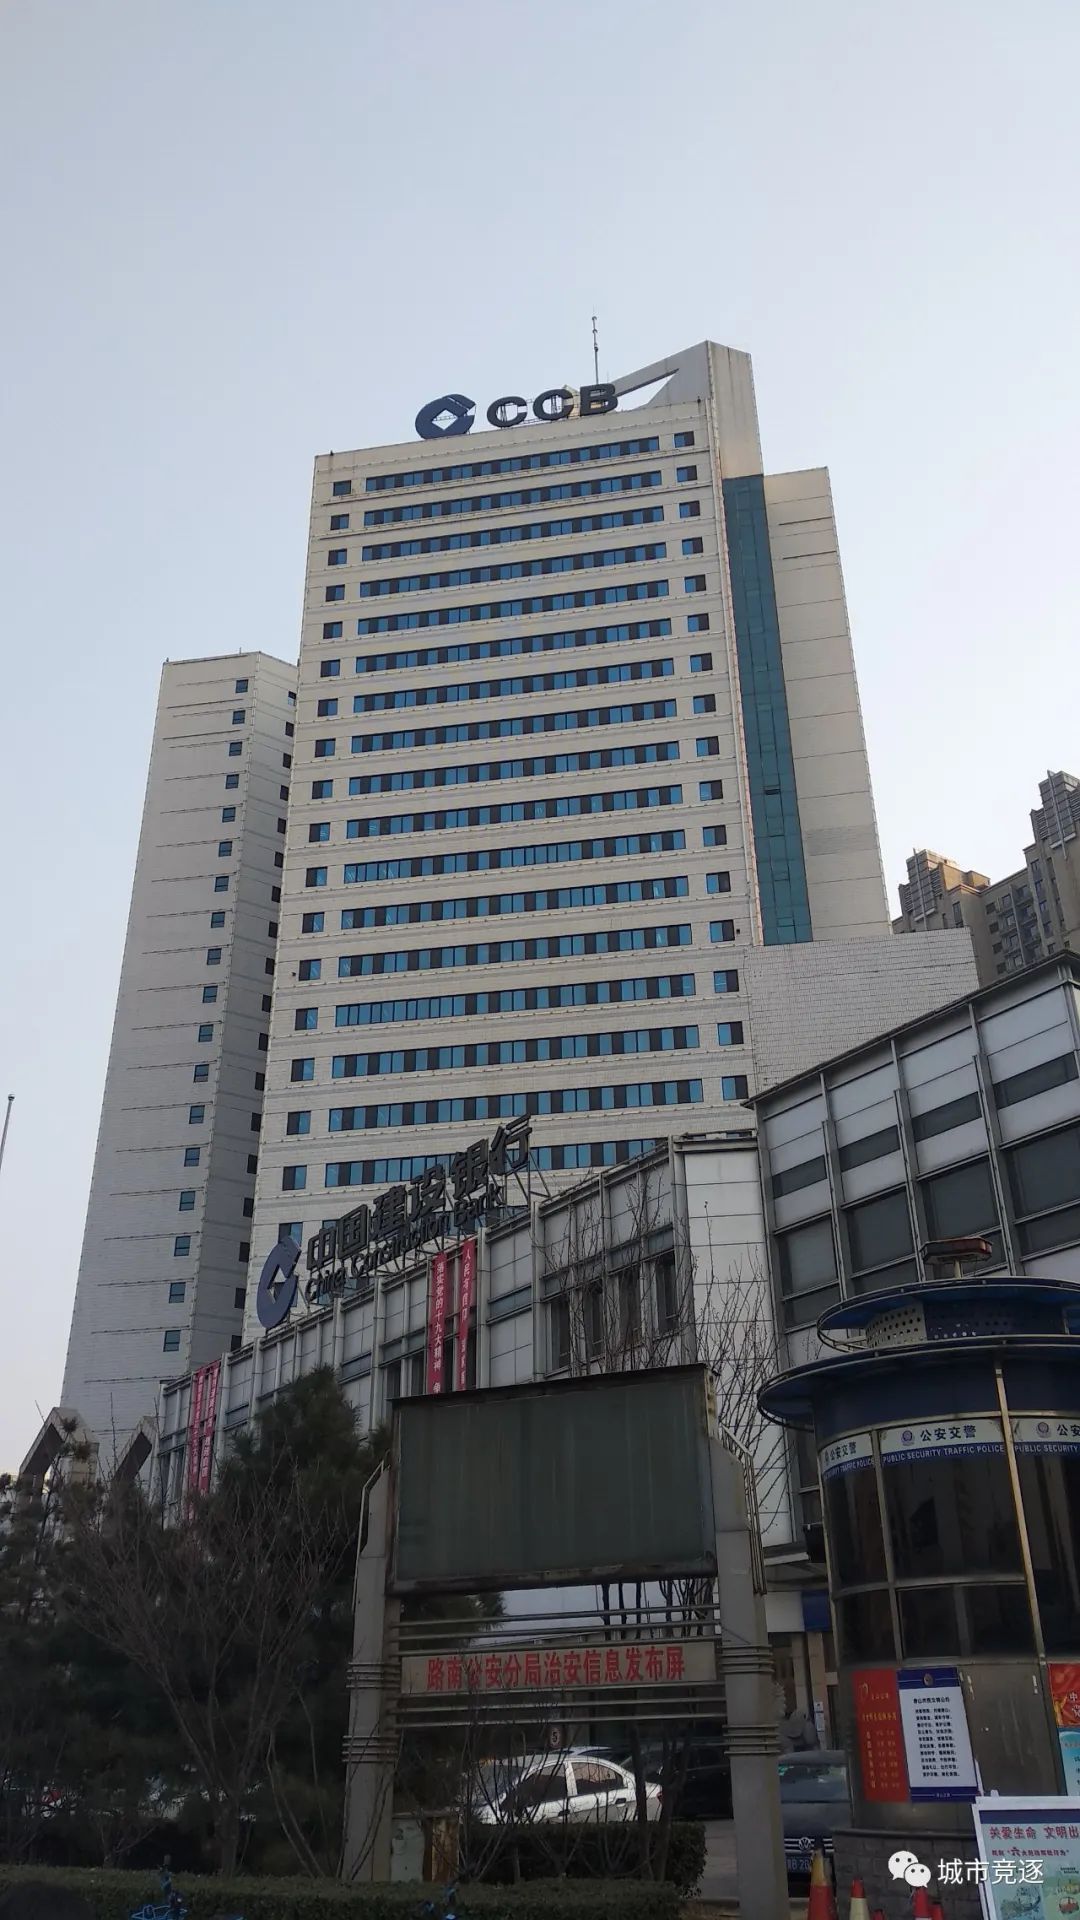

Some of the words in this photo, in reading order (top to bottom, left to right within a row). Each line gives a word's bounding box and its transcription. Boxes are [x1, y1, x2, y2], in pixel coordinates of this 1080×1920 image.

[486, 383, 619, 428] CCB
[306, 1114, 532, 1270] 中国建设银行
[305, 1266, 345, 1303] China
[351, 1213, 450, 1279] Construction
[454, 1183, 504, 1227] Bank
[920, 1425, 977, 1442] 公安交警
[830, 1441, 857, 1460] 公安交警
[883, 1453, 906, 1464] PUBLIC
[907, 1448, 941, 1460] SECURITY
[944, 1446, 974, 1456] TRAFFIC
[977, 1444, 1005, 1453] POLICE
[1015, 1444, 1041, 1453] PUBLIC
[1043, 1444, 1078, 1453] SECURITY
[427, 1646, 686, 1691] 路南公安分局治安信息发布屏
[989, 1826, 1037, 1840] 关爱生命
[1043, 1825, 1079, 1840] 文明出
